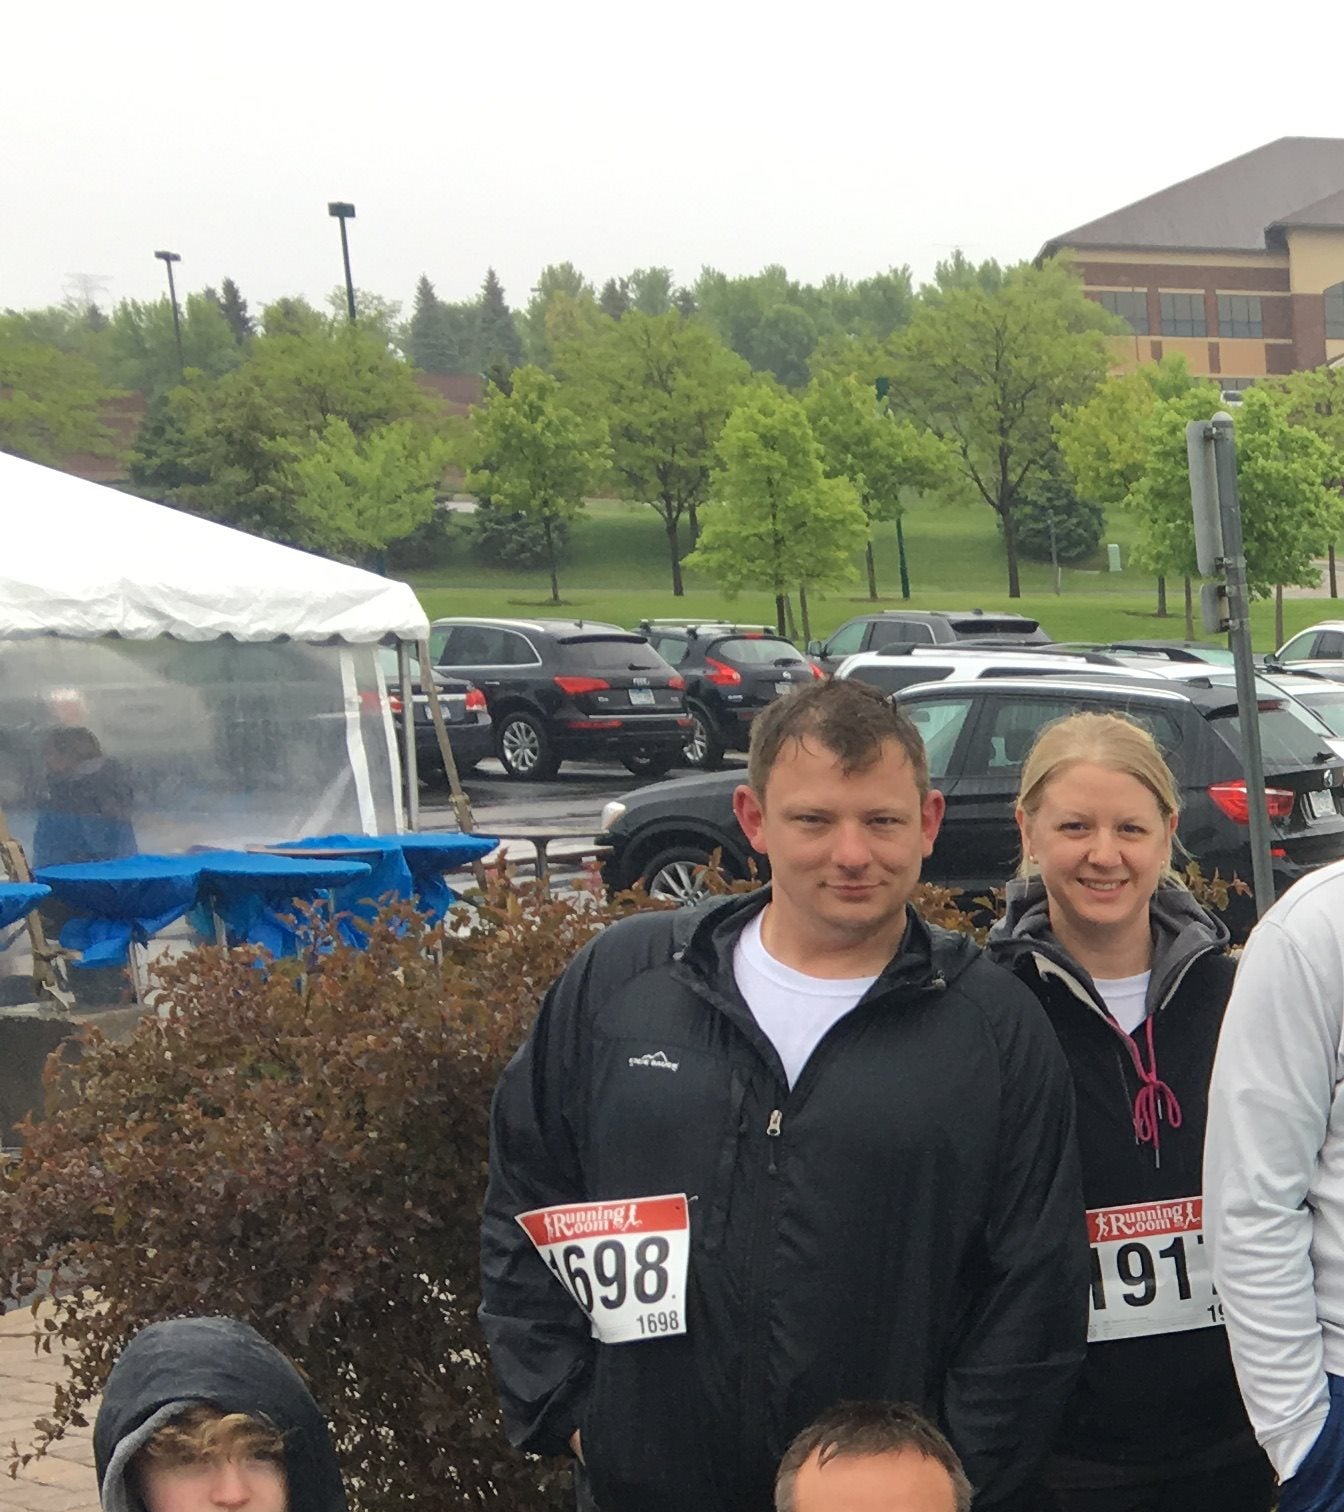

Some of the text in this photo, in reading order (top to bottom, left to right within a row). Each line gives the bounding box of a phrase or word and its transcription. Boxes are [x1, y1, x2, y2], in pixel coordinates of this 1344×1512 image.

[552, 1205, 626, 1237] Running
[1108, 1204, 1183, 1236] Running
[1090, 1234, 1217, 1310] 191
[637, 1310, 679, 1335] 1698
